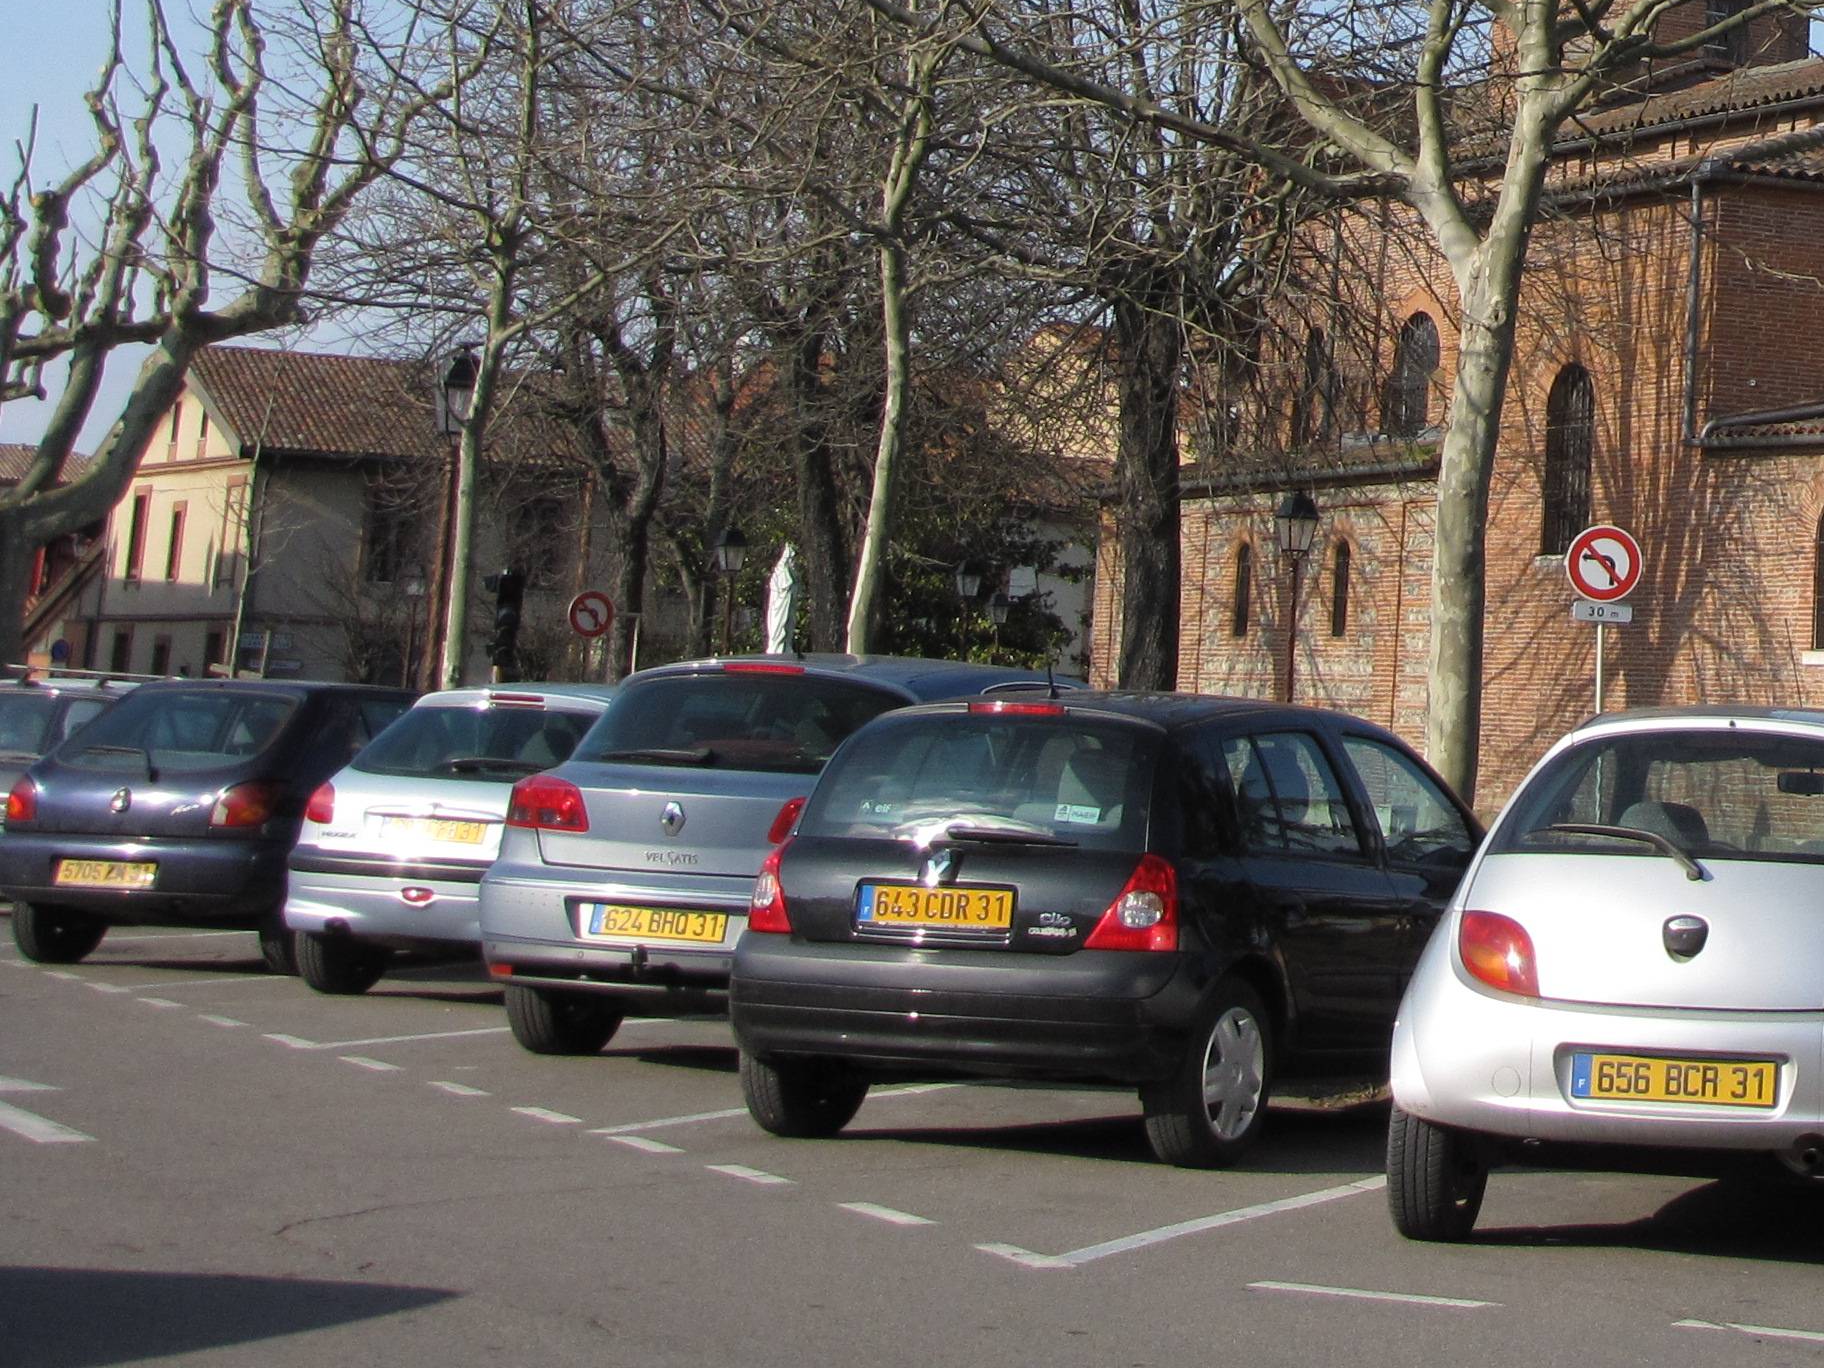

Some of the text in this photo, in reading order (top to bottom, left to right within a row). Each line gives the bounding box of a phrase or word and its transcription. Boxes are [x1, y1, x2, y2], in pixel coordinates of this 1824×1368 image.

[1588, 606, 1604, 617] 30
[64, 862, 101, 879] 5705
[876, 890, 922, 918] 643
[924, 892, 970, 920] CDR
[977, 894, 1005, 922] 31
[604, 908, 643, 931] 624
[692, 914, 718, 938] 31
[1579, 1061, 1766, 1100] F 656 BCR 31
